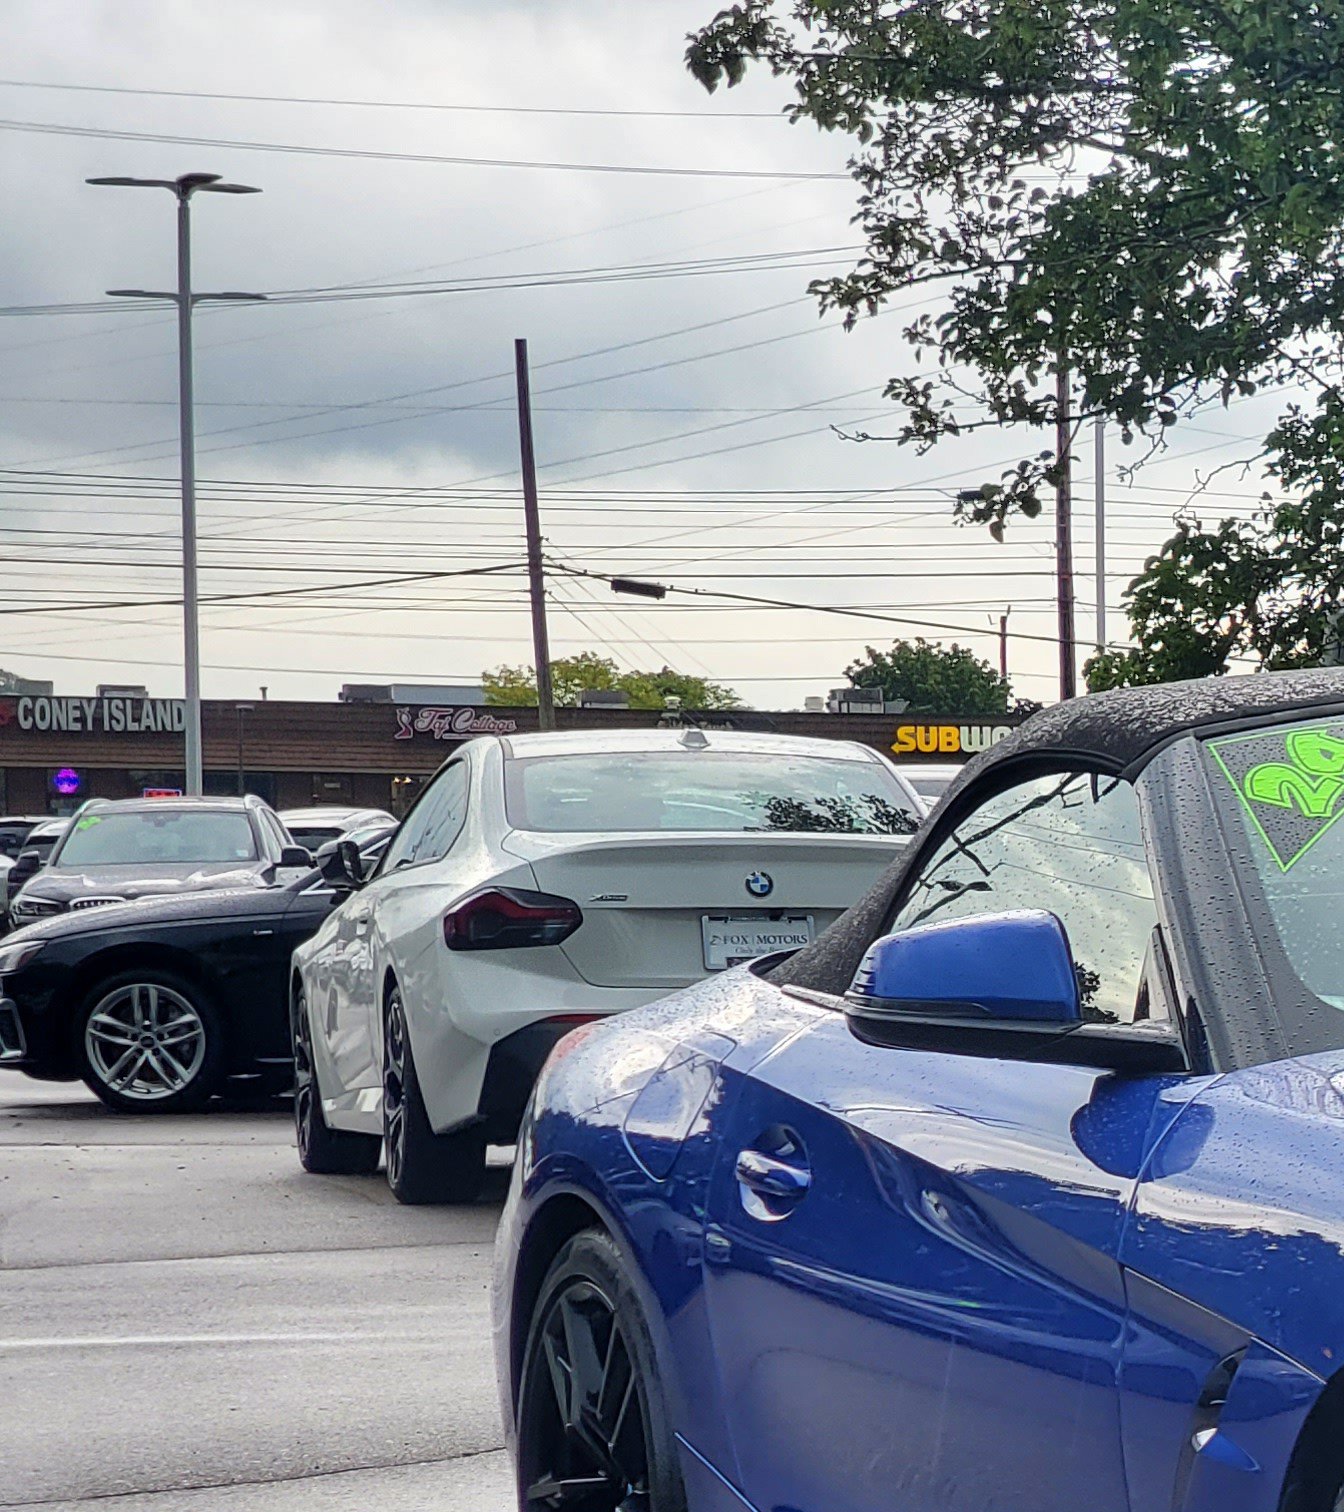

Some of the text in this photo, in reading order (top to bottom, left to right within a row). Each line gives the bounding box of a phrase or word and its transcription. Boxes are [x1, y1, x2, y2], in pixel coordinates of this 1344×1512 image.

[18, 697, 96, 730] CONEY
[103, 699, 186, 731] ISLAND
[414, 707, 517, 739] Taj Cottage
[724, 934, 808, 945] FOX MOTORS
